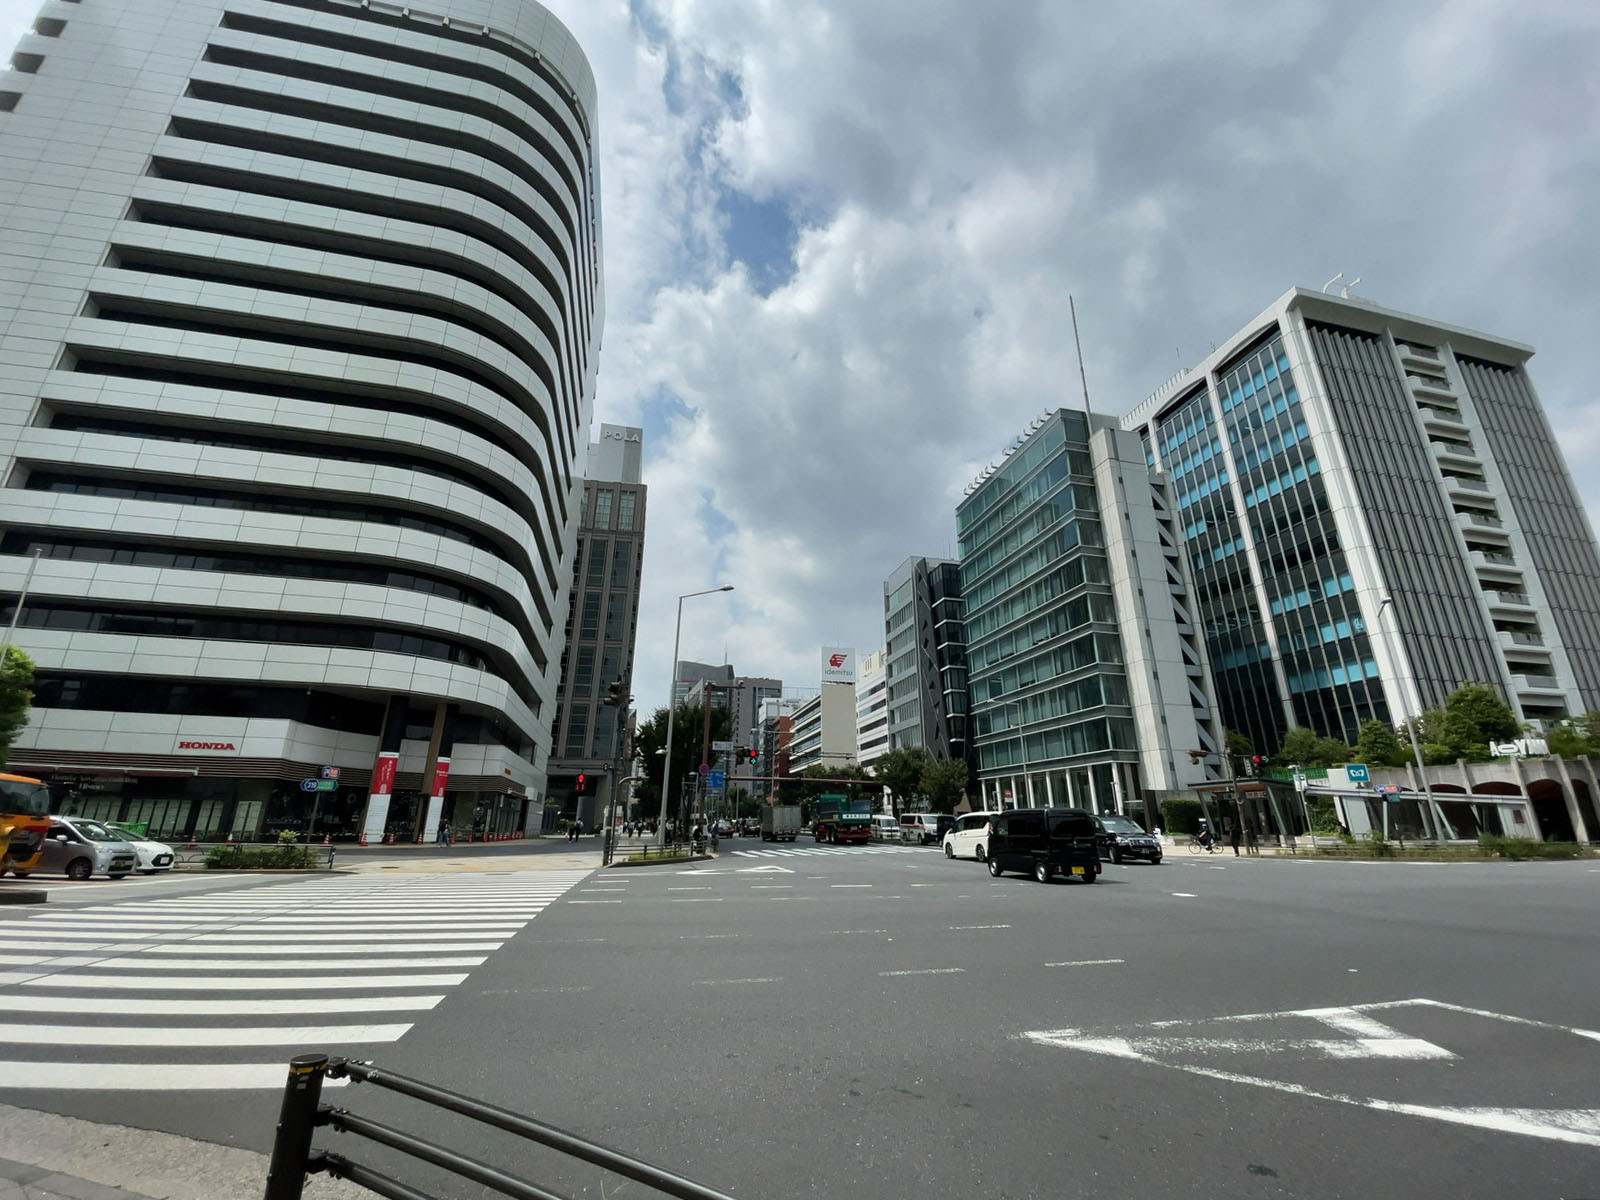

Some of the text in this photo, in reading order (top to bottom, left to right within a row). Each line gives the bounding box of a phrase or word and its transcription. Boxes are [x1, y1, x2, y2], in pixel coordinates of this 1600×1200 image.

[604, 431, 640, 443] POLA
[824, 667, 853, 676] idemitsu
[178, 741, 236, 751] HONDA
